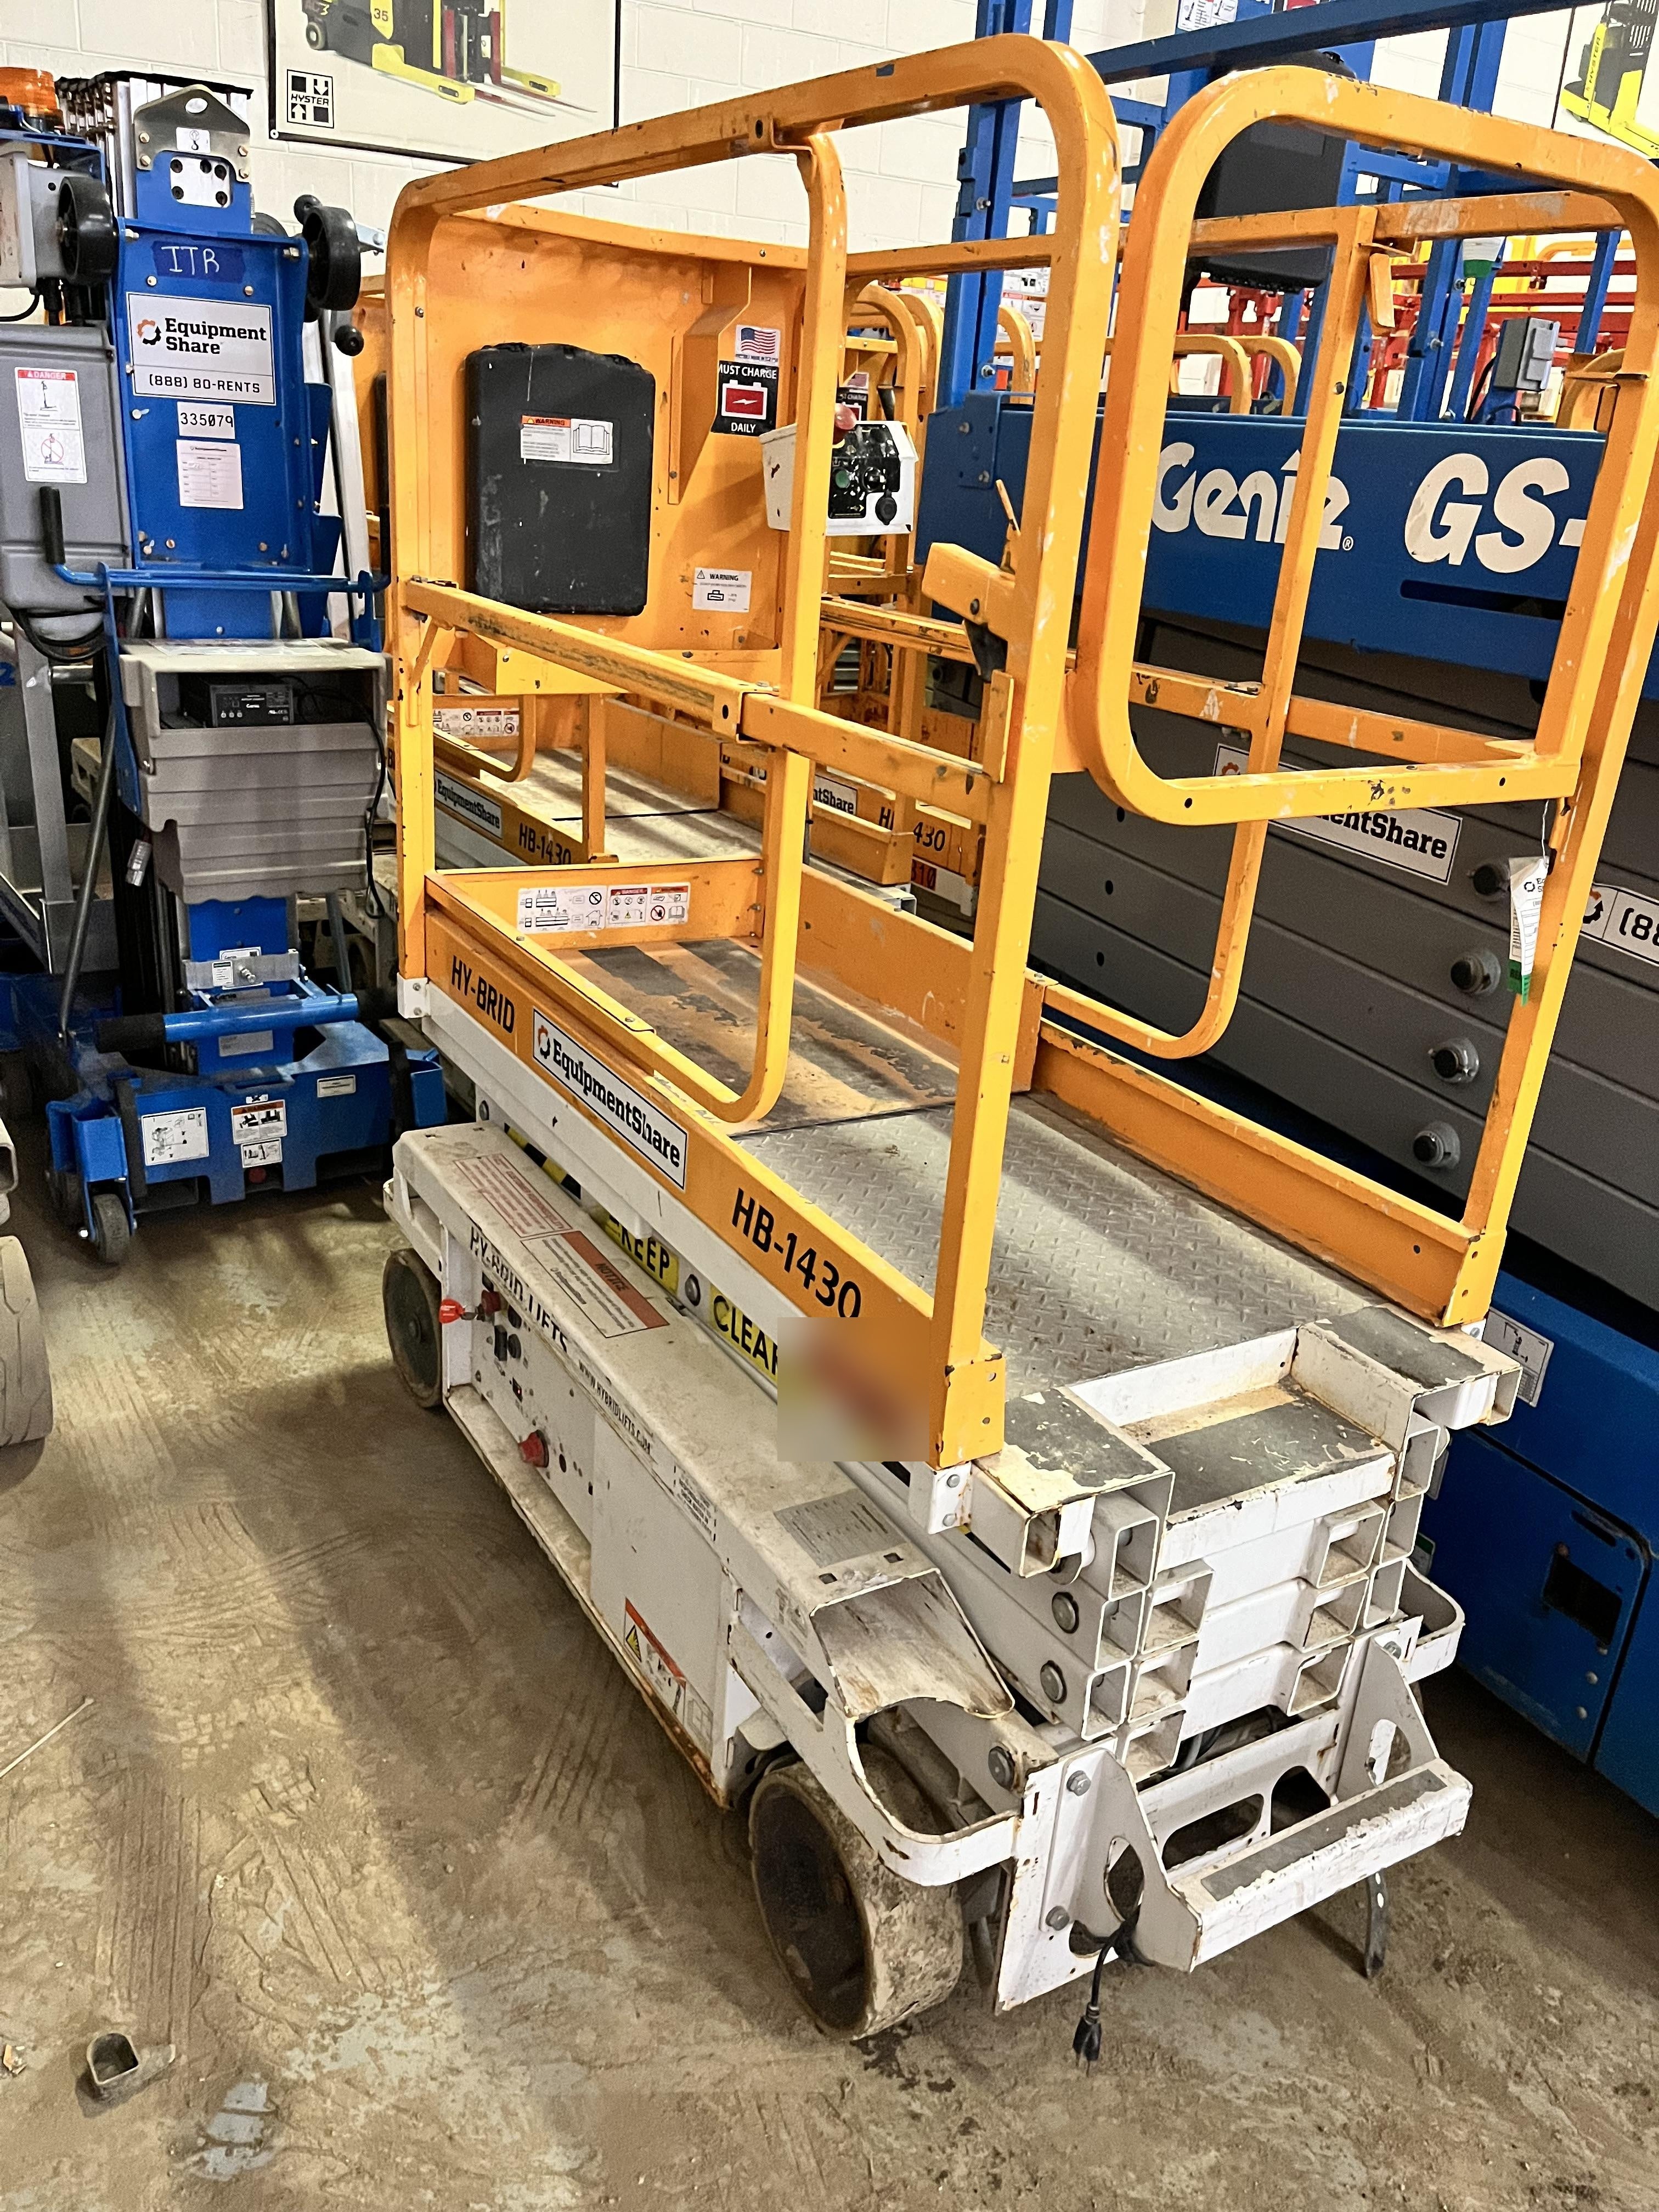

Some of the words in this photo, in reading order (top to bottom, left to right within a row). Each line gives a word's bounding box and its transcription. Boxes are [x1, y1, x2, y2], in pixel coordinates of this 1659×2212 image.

[374, 8, 388, 21] 35
[291, 93, 329, 105] HYSTER
[165, 317, 267, 341] Equipment
[166, 336, 220, 354] Share
[742, 366, 777, 379] CHARGE
[149, 374, 188, 388] (888)
[193, 377, 260, 393] 80-RENTS
[180, 412, 233, 428] 335079
[731, 422, 756, 433] DAILY
[437, 778, 500, 830] EquipmentShare
[519, 823, 572, 865] HB-1430
[451, 955, 515, 1034] HY-BRID
[553, 1038, 680, 1168] EquipmentShare
[732, 1188, 862, 1317] HB-1430
